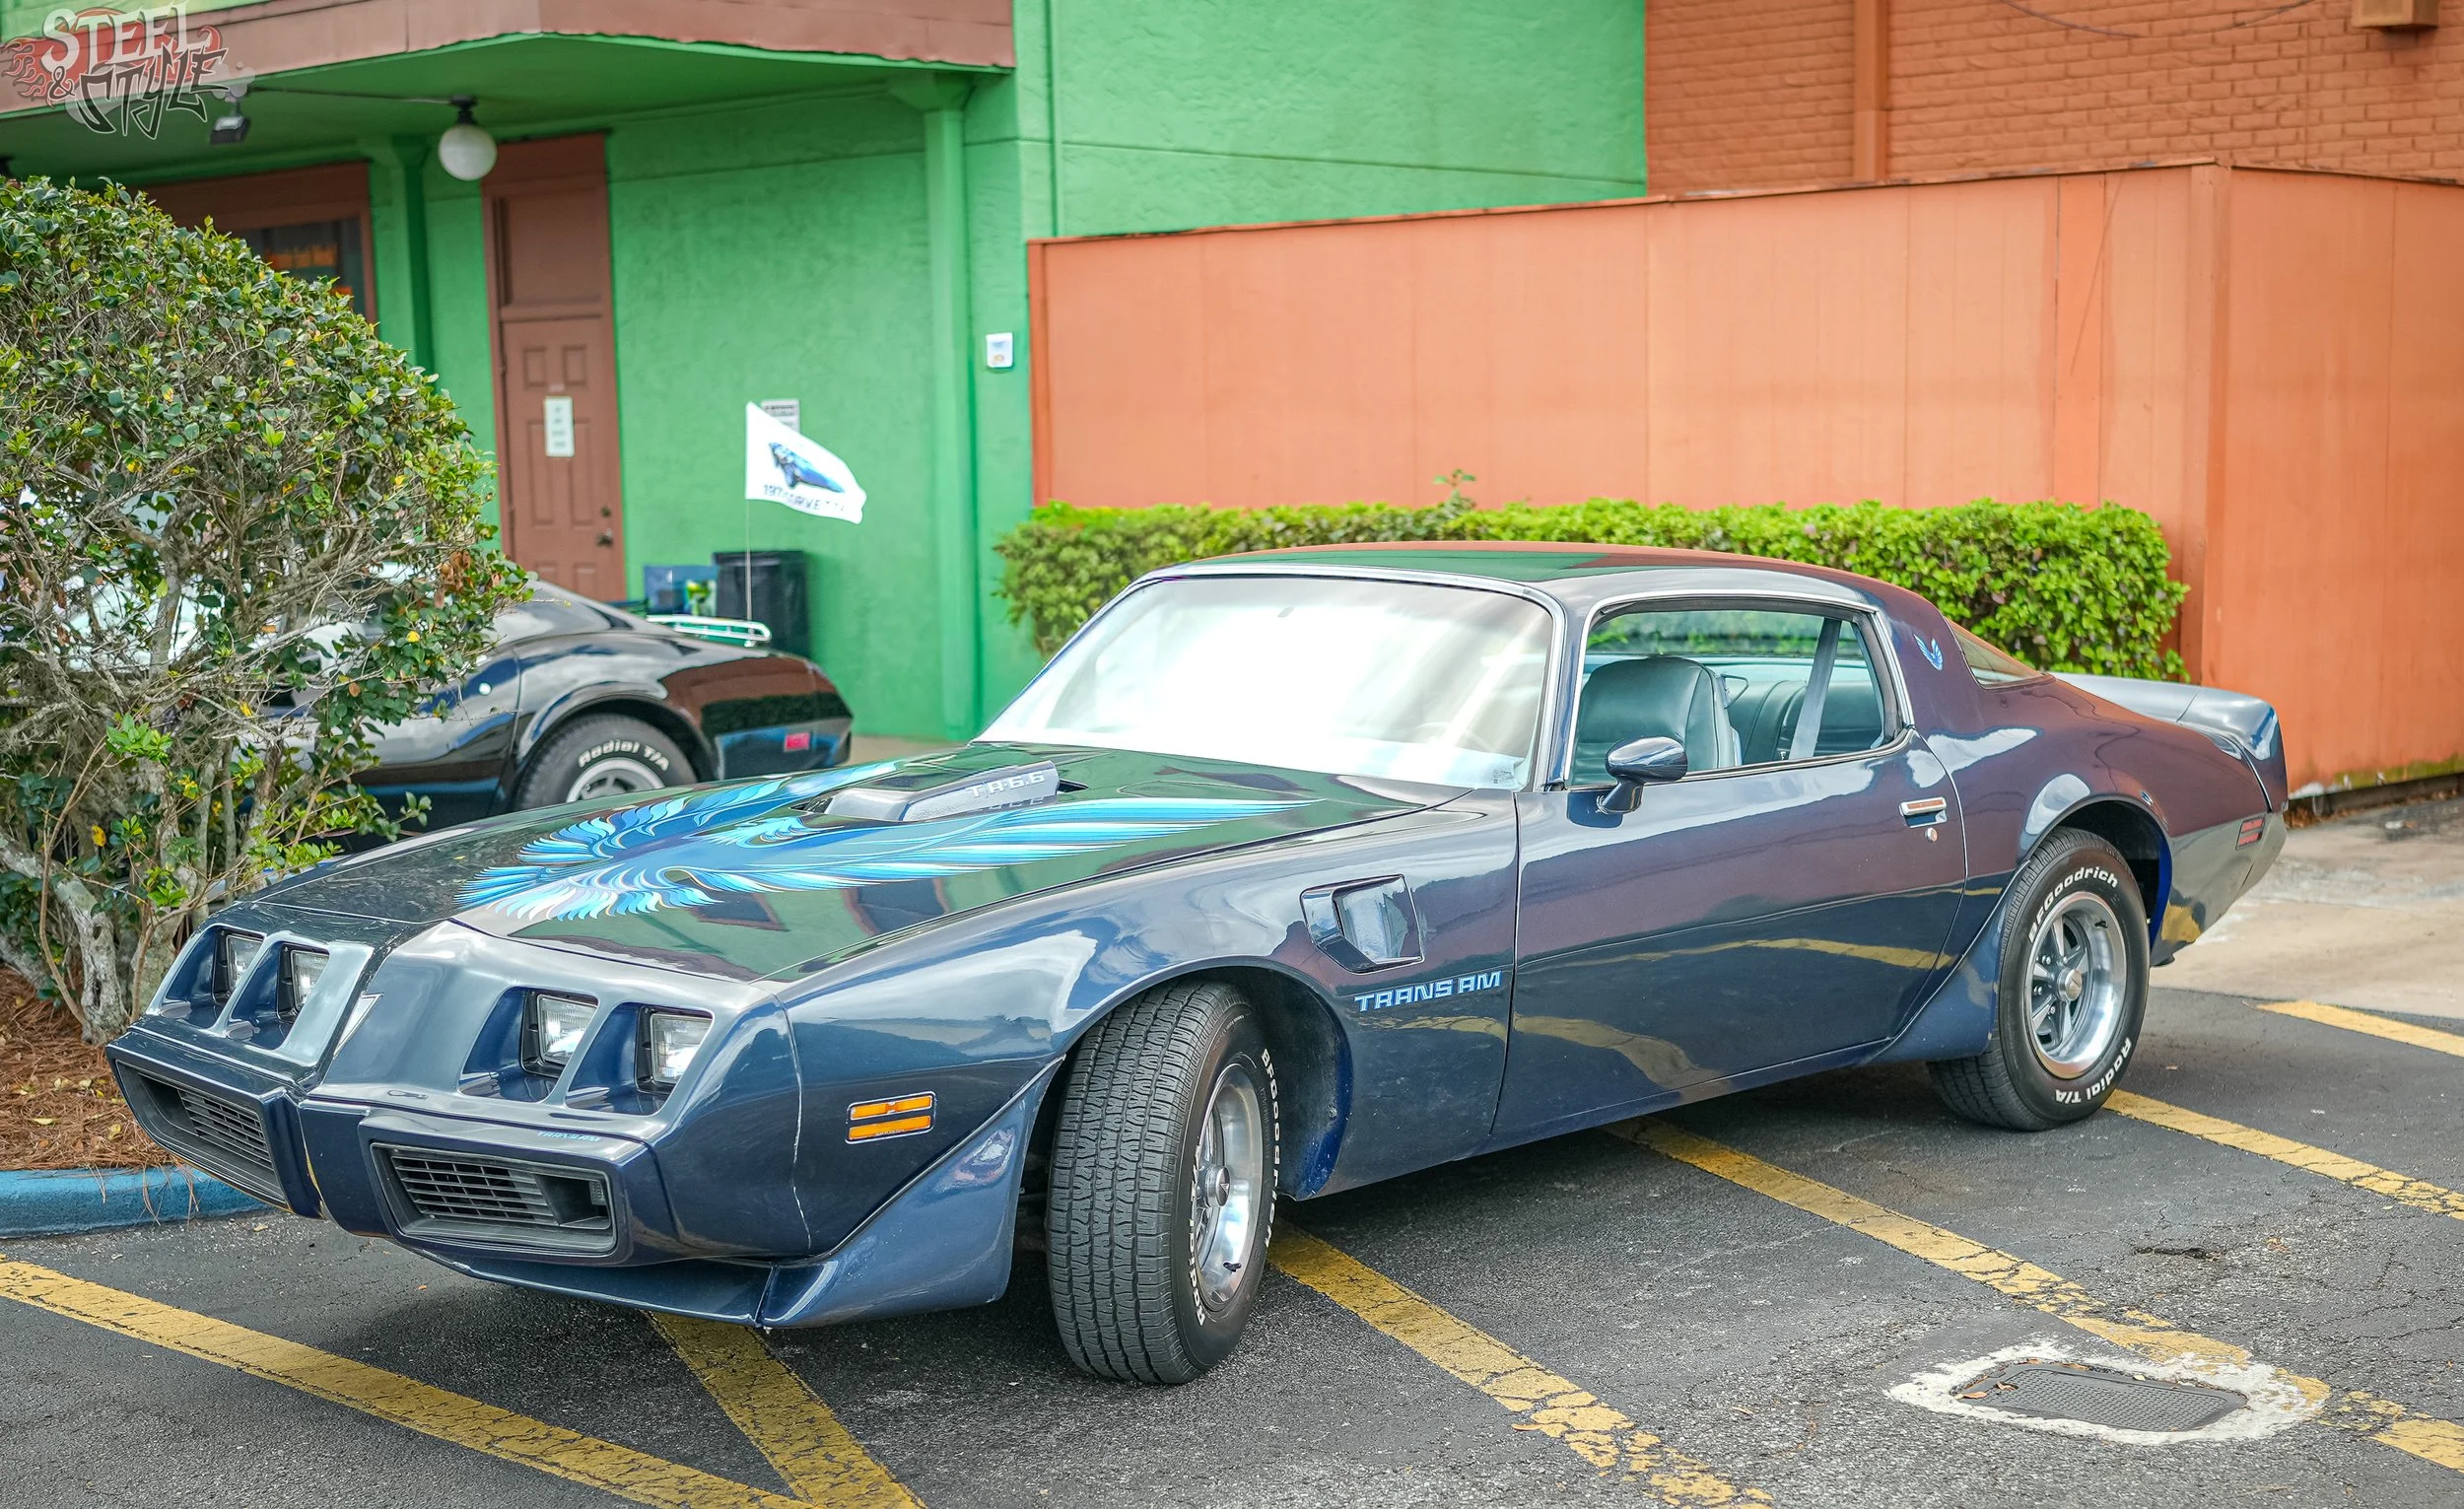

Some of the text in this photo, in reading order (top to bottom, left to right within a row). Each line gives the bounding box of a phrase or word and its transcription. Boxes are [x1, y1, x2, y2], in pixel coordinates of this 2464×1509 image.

[579, 739, 670, 771] Radial T/A
[2028, 866, 2118, 943] BFGoodrich
[1354, 970, 1502, 1012] TRANS AM
[2055, 1037, 2132, 1104] Radial T/A
[1261, 1048, 1280, 1248] BFGoodrich
